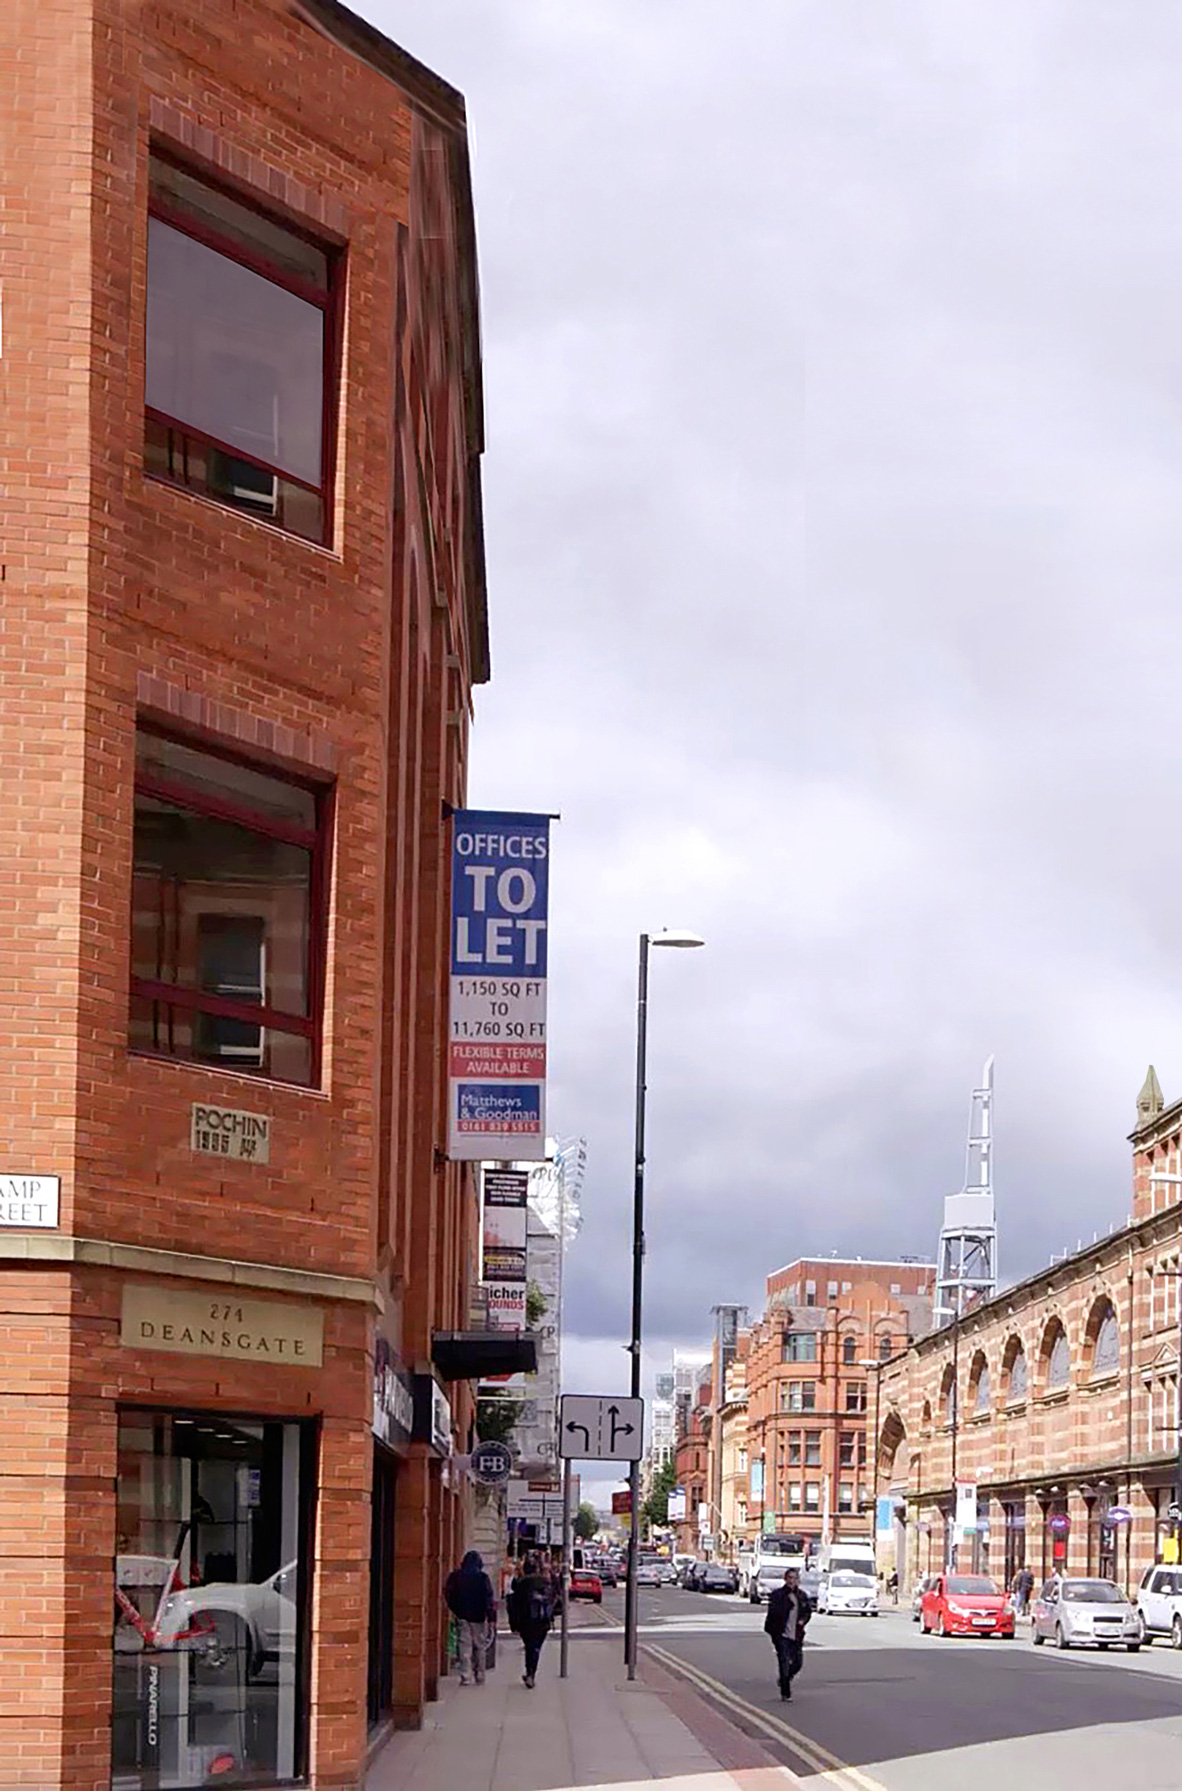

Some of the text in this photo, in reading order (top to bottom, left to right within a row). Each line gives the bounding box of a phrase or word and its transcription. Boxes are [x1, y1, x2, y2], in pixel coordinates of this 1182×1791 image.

[456, 833, 547, 859] OFFICES
[465, 865, 536, 914] TO
[456, 917, 546, 965] LET
[458, 981, 541, 998] 1,150 SQ FT
[489, 1002, 509, 1016] TO
[453, 1021, 545, 1038] 11,760 SQ FT
[452, 1046, 545, 1060] FLEXIBLE TERMS
[466, 1061, 530, 1074] AVAILABLE
[460, 1094, 522, 1107] Matthews
[460, 1107, 537, 1120] & Goodman
[195, 1107, 267, 1139] POCHIN
[0, 1180, 41, 1198] MP
[488, 1287, 525, 1300] icher
[210, 1303, 244, 1323] 274
[488, 1300, 524, 1311] OUNDS
[140, 1321, 305, 1355] DEANSGATE
